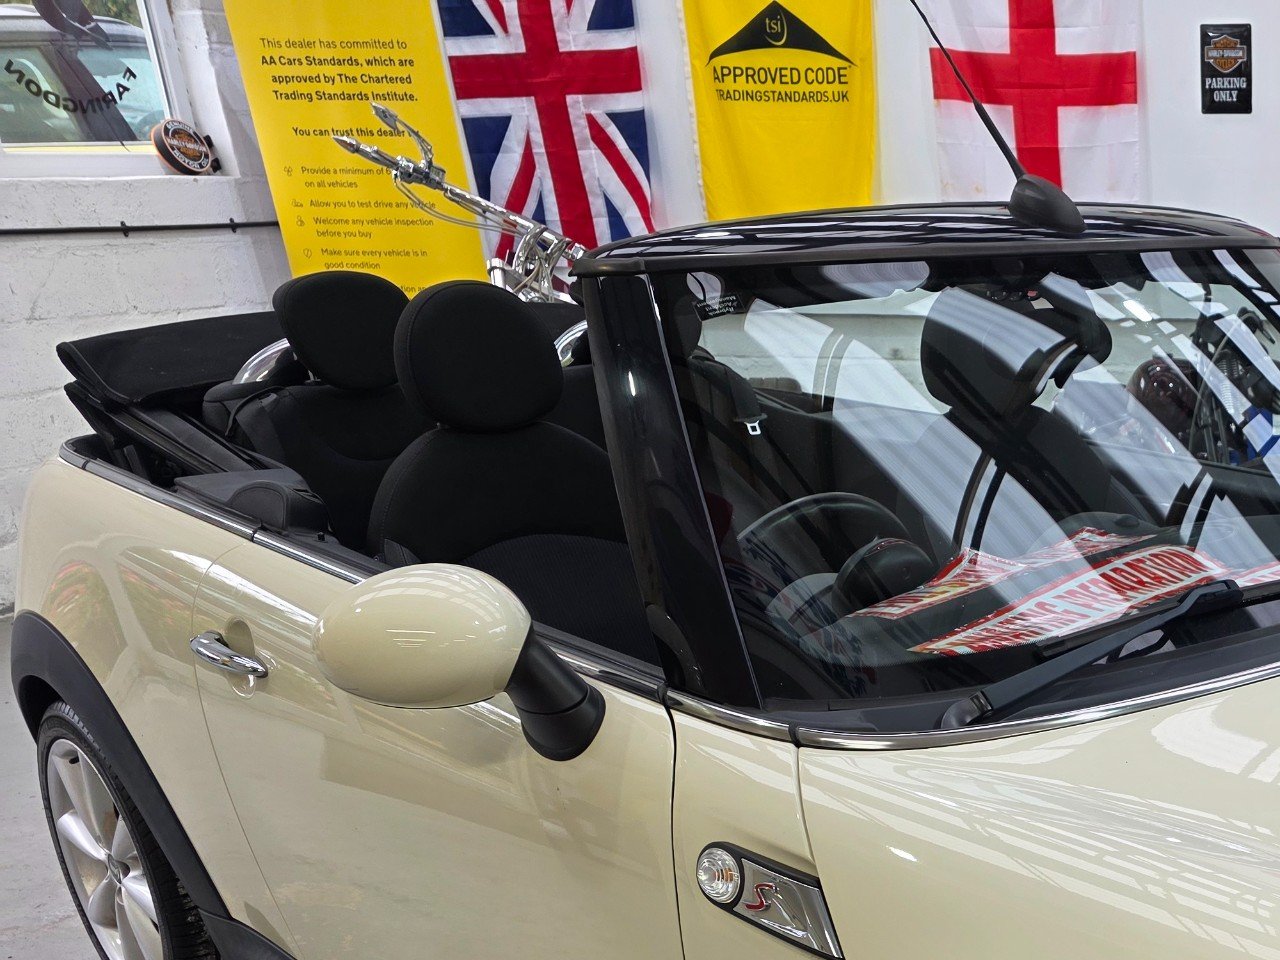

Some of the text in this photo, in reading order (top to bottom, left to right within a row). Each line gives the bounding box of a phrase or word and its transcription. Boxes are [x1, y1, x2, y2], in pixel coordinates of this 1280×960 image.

[765, 16, 781, 33] tsi
[260, 38, 407, 50] This dealer has committed to
[261, 55, 415, 68] AA Cars Standards, which are
[271, 74, 412, 86] approved by The Chartered
[713, 66, 849, 85] APPROVED CODE
[1205, 77, 1247, 89] PARKING
[273, 90, 418, 103] Trading Standards Institute.
[716, 89, 850, 103] TRADINGSTANDARDS.UK
[1213, 90, 1238, 102] ONLY
[292, 127, 311, 137] You
[313, 129, 330, 137] can
[332, 128, 354, 137] trust
[355, 128, 375, 137] this
[301, 166, 331, 175] Provide
[339, 167, 373, 176] minimum
[375, 167, 384, 176] of
[316, 180, 326, 188] all
[328, 180, 358, 188] vehicles
[309, 200, 436, 210] Allow you to test drive any vecle
[313, 216, 434, 228] Welcome any vehicle inspection
[316, 229, 372, 239] before you buy
[321, 248, 428, 258] Make sure every vehicle is in
[324, 261, 381, 270] good condition
[745, 882, 776, 911] S
